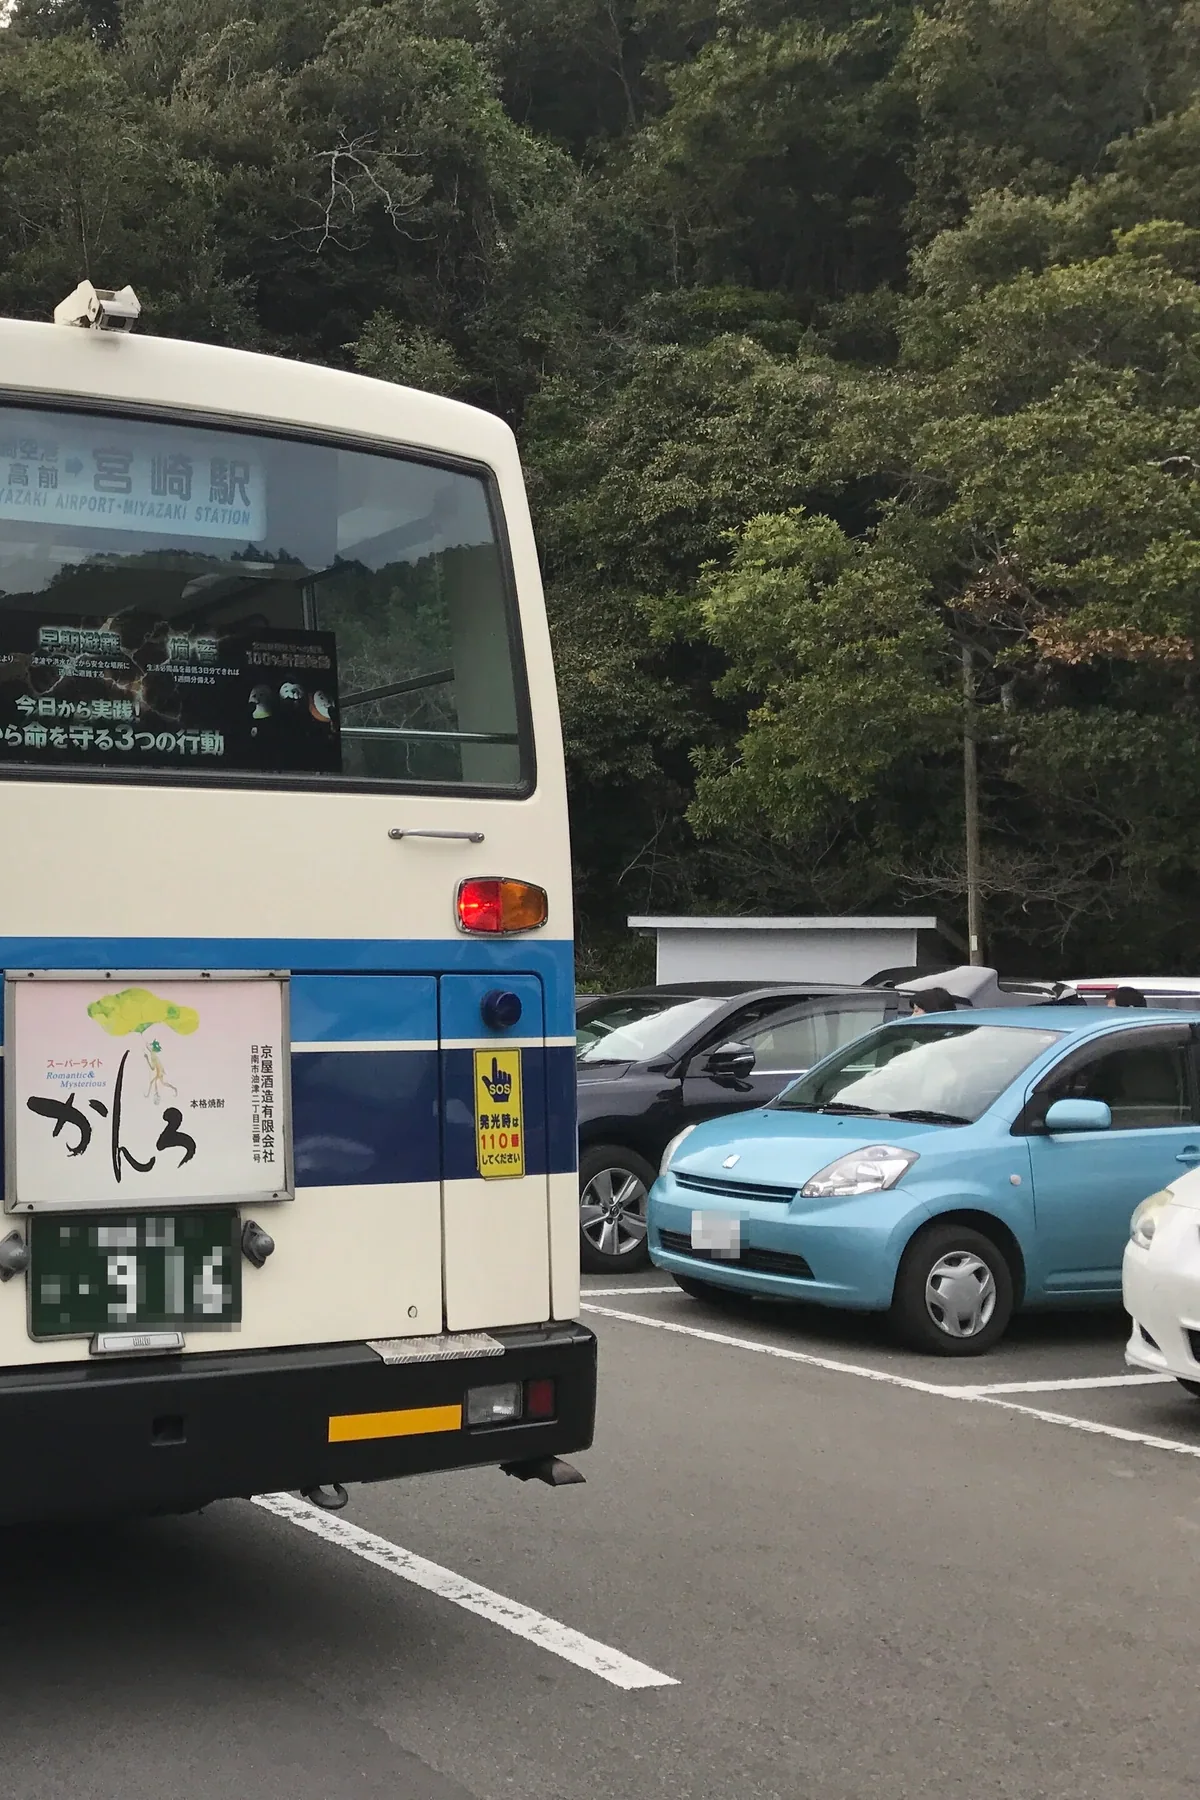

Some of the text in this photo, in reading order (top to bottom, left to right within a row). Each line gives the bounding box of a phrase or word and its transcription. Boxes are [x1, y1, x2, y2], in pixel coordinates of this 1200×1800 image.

[91, 446, 251, 507] 宮崎駅
[194, 505, 251, 526] STATION
[40, 628, 121, 656] 早期避難
[46, 1058, 103, 1069] スーパーライト
[60, 1080, 107, 1090] Mysterious
[489, 1083, 511, 1095] SOS
[260, 1044, 276, 1163] 京屋酒造有限会社
[479, 1113, 520, 1130] 発光時は
[481, 1152, 521, 1166] してください
